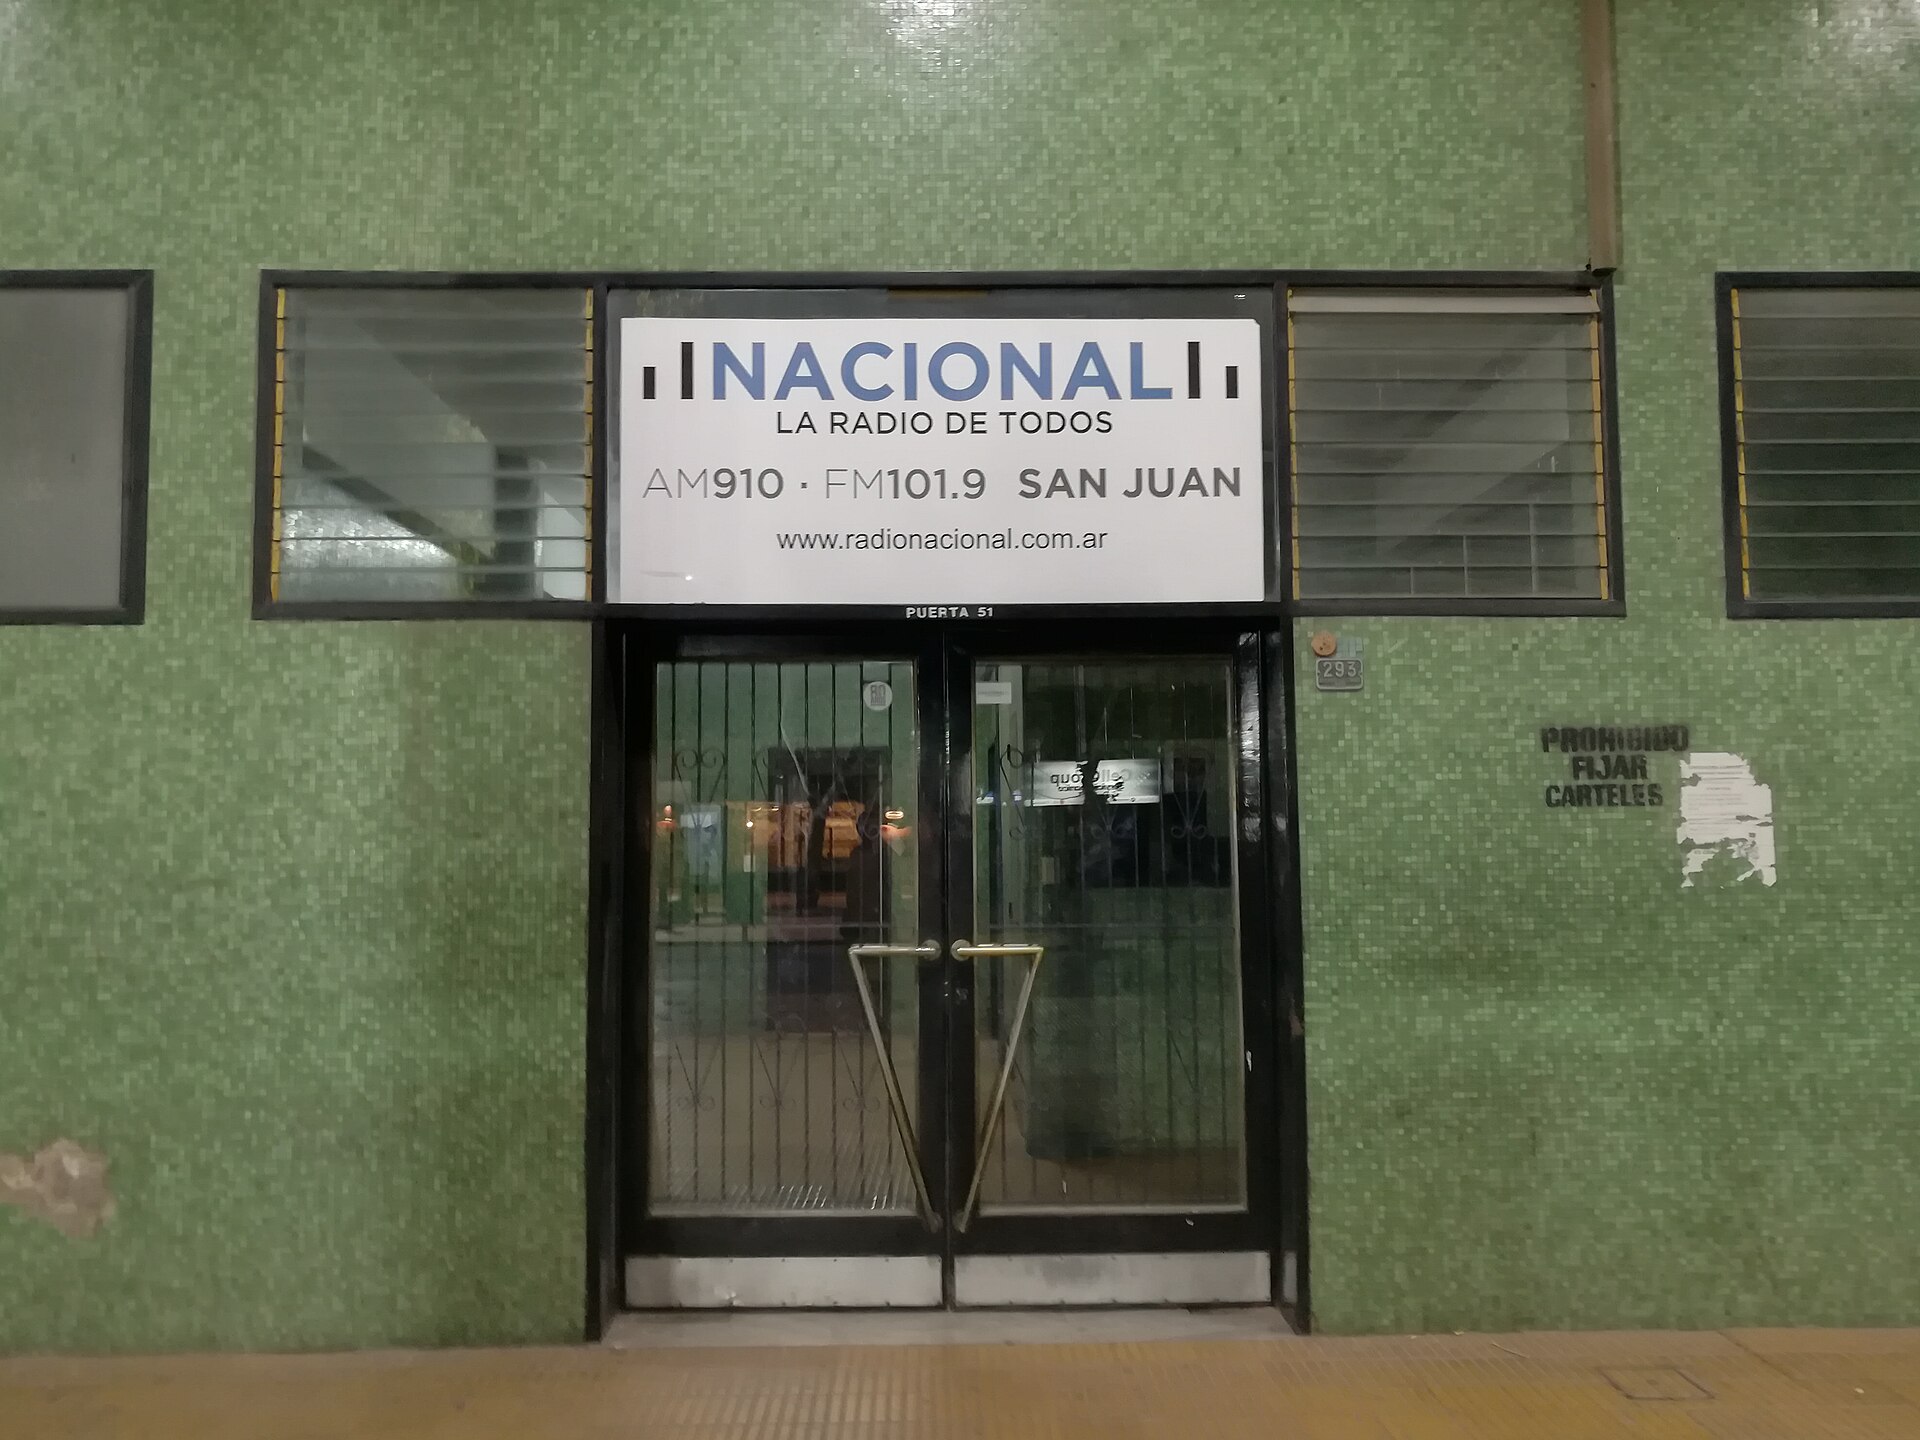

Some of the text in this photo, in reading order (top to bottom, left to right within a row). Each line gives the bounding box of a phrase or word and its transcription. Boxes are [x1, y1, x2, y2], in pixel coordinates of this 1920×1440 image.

[712, 342, 1173, 401] NACIONAL
[777, 411, 1112, 434] LA RADIO DE TODOS
[642, 467, 1241, 499] AM910 FM101.9 SAN JUAN
[776, 528, 1108, 549] www.radionacional.com.ar
[906, 606, 993, 618] PUERTA 51
[1323, 661, 1357, 678] 293
[1541, 725, 1689, 752] PROHIBIDO
[1572, 755, 1648, 780] FIJAR
[1545, 783, 1664, 808] CARTELES
